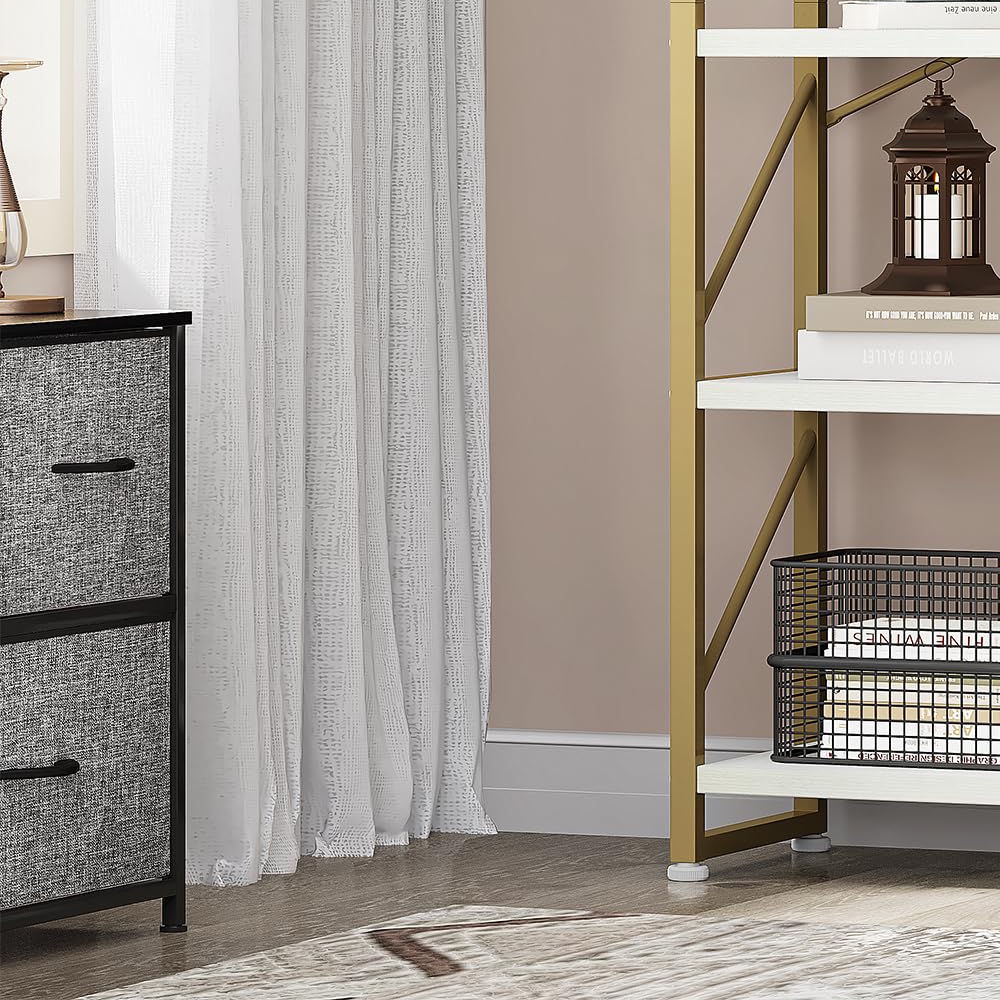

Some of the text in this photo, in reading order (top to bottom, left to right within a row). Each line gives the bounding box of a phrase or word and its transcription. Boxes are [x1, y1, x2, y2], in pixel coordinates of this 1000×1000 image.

[944, 5, 959, 14] Zeit
[961, 6, 980, 14] neue
[981, 6, 998, 14] eine
[853, 632, 924, 646] WINES
